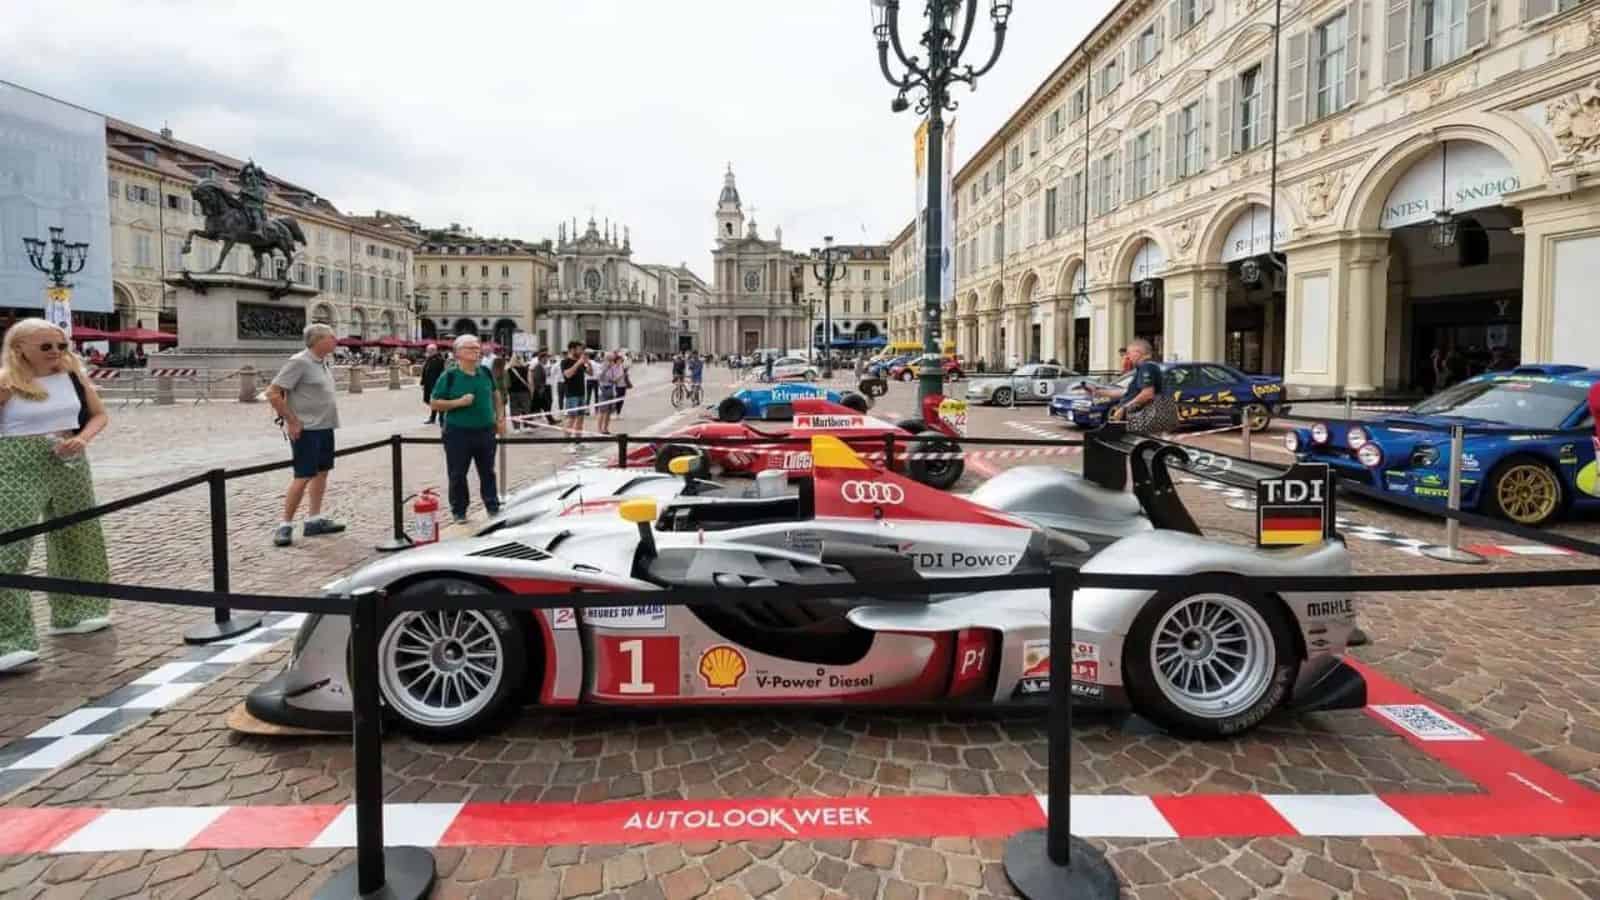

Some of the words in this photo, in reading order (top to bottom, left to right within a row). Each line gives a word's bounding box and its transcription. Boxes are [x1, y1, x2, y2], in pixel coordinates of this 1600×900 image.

[1039, 382, 1048, 394] 3
[812, 415, 850, 427] Marlboro
[1261, 479, 1324, 502] TDI
[951, 552, 1016, 568] Power
[621, 607, 634, 617] DU
[1307, 600, 1353, 617] MAHLE
[619, 639, 655, 694] 1
[960, 647, 985, 675] P1
[756, 675, 822, 688] V-Power
[829, 673, 874, 688] Diesel
[624, 808, 799, 834] AUTOLOOK
[793, 807, 872, 826] WEEK
